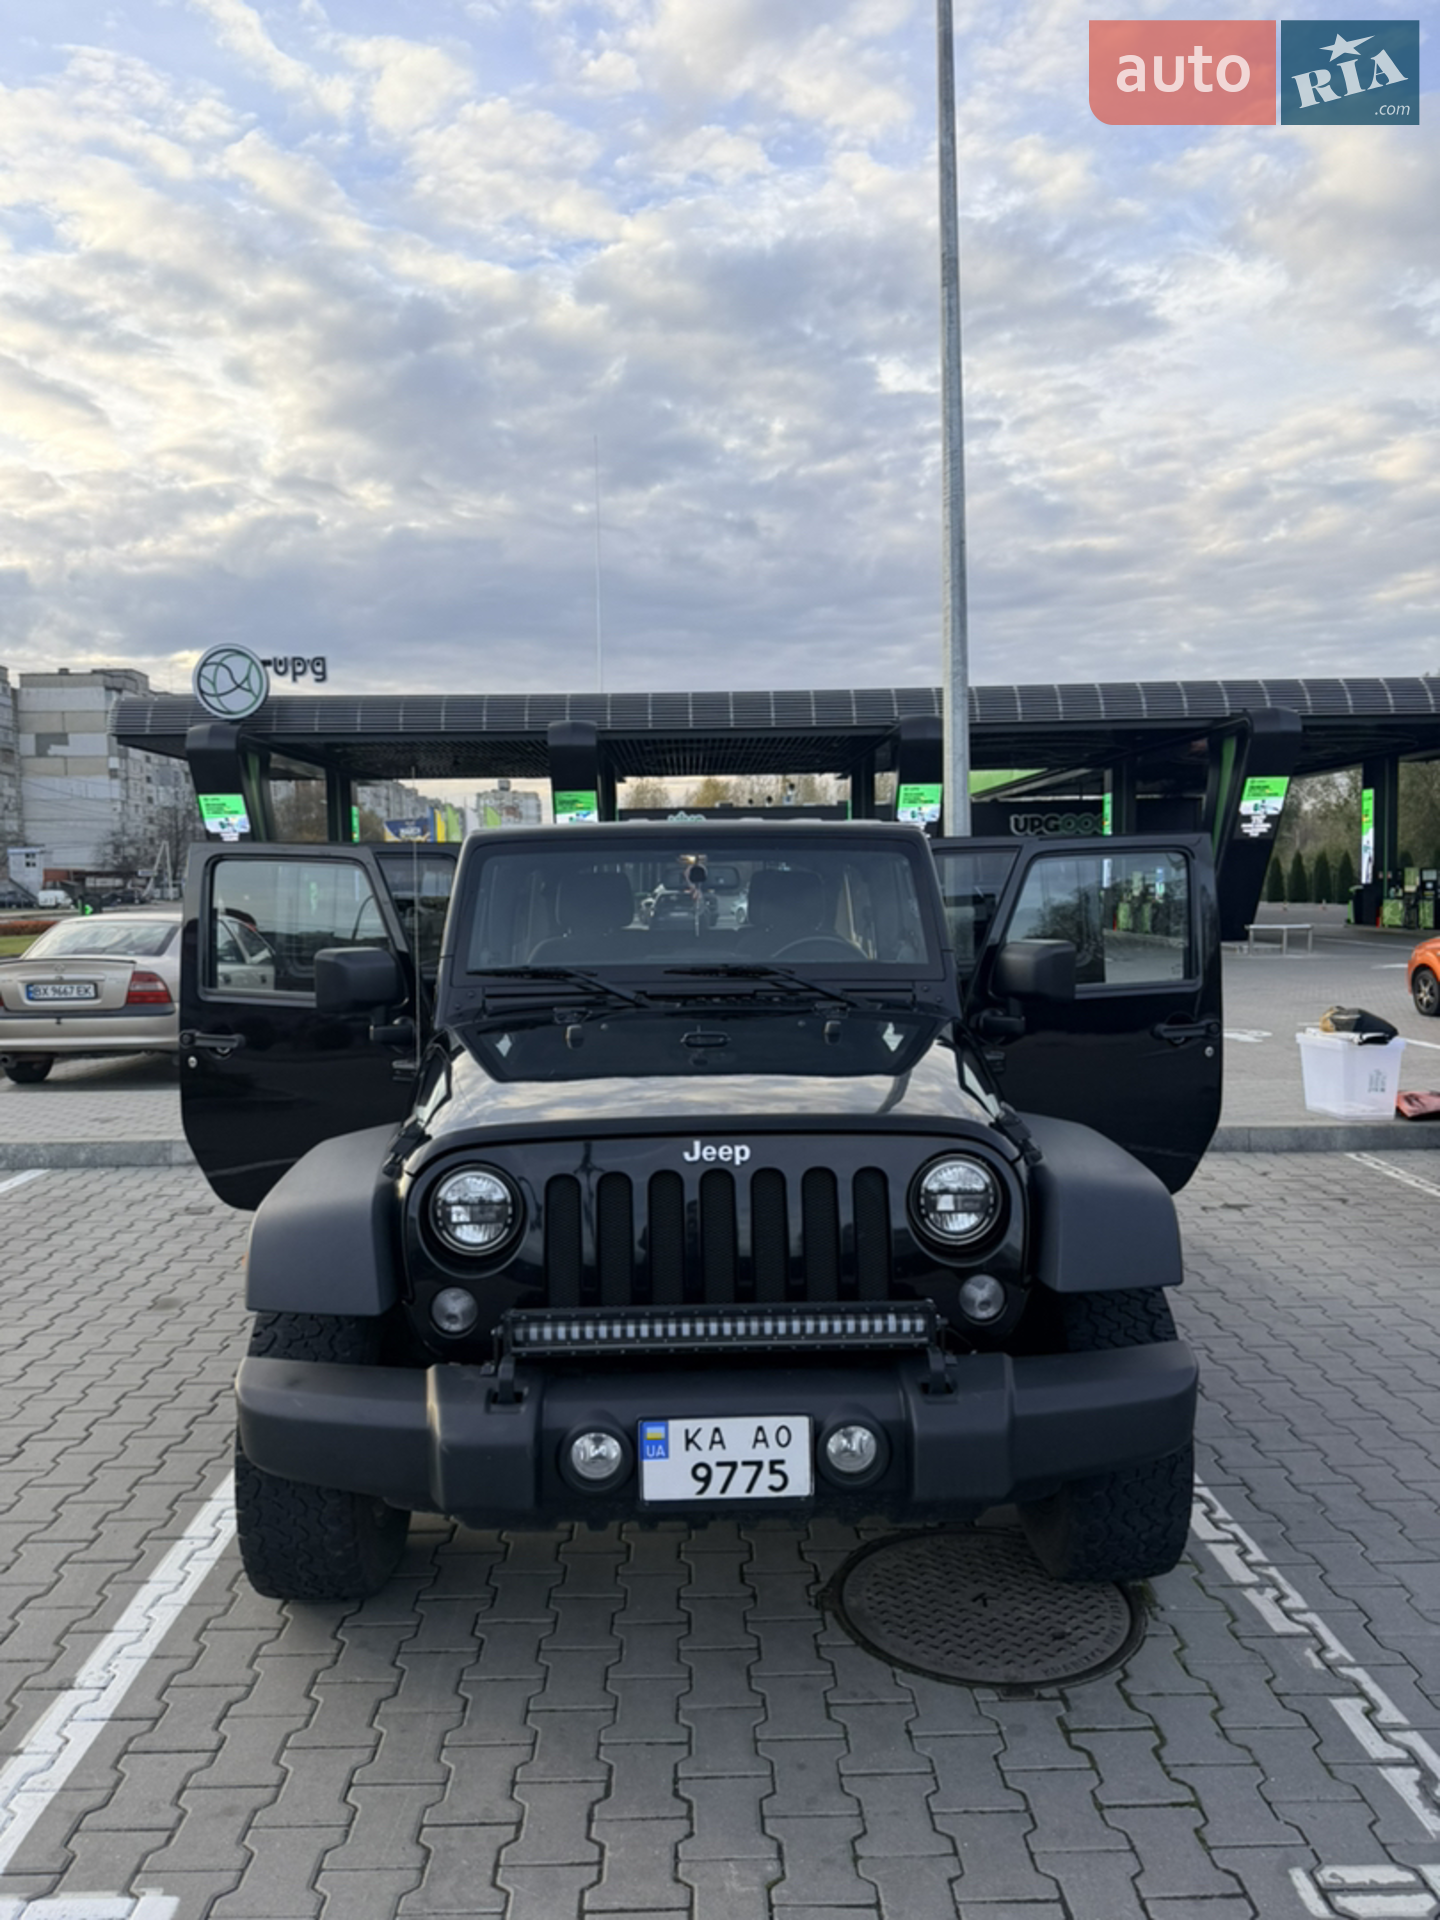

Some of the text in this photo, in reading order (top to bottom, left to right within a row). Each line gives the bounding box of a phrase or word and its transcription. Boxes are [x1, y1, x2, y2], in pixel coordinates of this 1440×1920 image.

[273, 656, 328, 683] upg
[1010, 812, 1104, 837] UPGOO
[682, 1140, 751, 1166] Jeep
[684, 1424, 792, 1451] KA AO
[646, 1444, 666, 1458] UA
[690, 1458, 789, 1496] 9775
